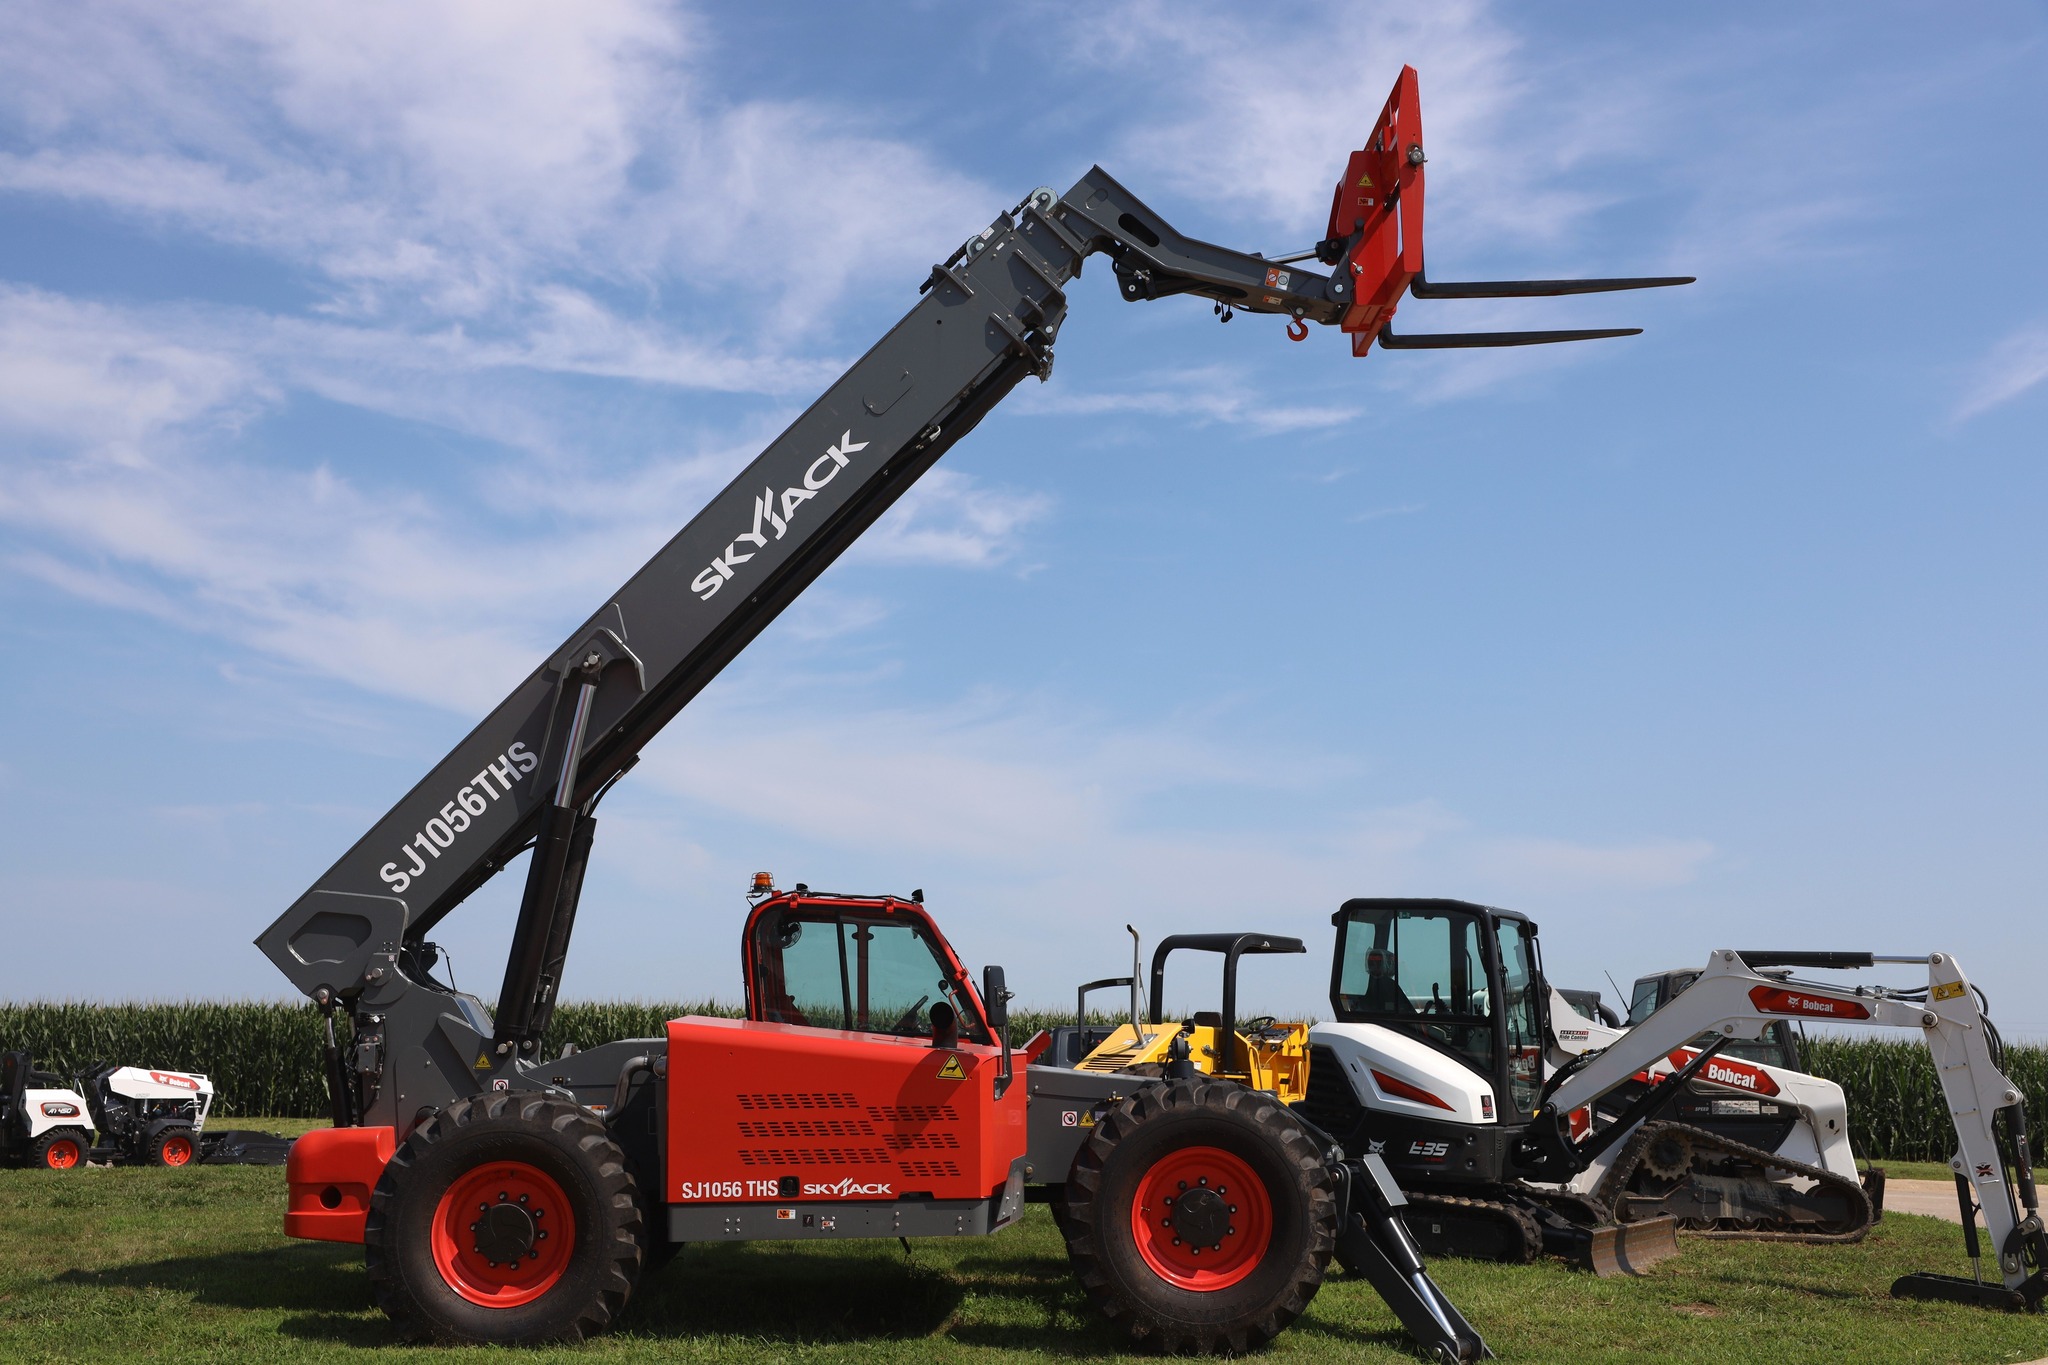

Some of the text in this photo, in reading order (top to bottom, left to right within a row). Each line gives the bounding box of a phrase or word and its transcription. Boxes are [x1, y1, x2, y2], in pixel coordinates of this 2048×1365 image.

[691, 428, 870, 601] SKYJACK
[379, 741, 539, 893] SJ1056THS
[1803, 999, 1834, 1013] Bobcat
[168, 1079, 191, 1089] Bobcat
[1708, 1064, 1757, 1089] Bobcat
[1409, 1141, 1449, 1157] E35
[682, 1180, 778, 1199] SJ1056 THS
[803, 1177, 893, 1197] SKYJACK
